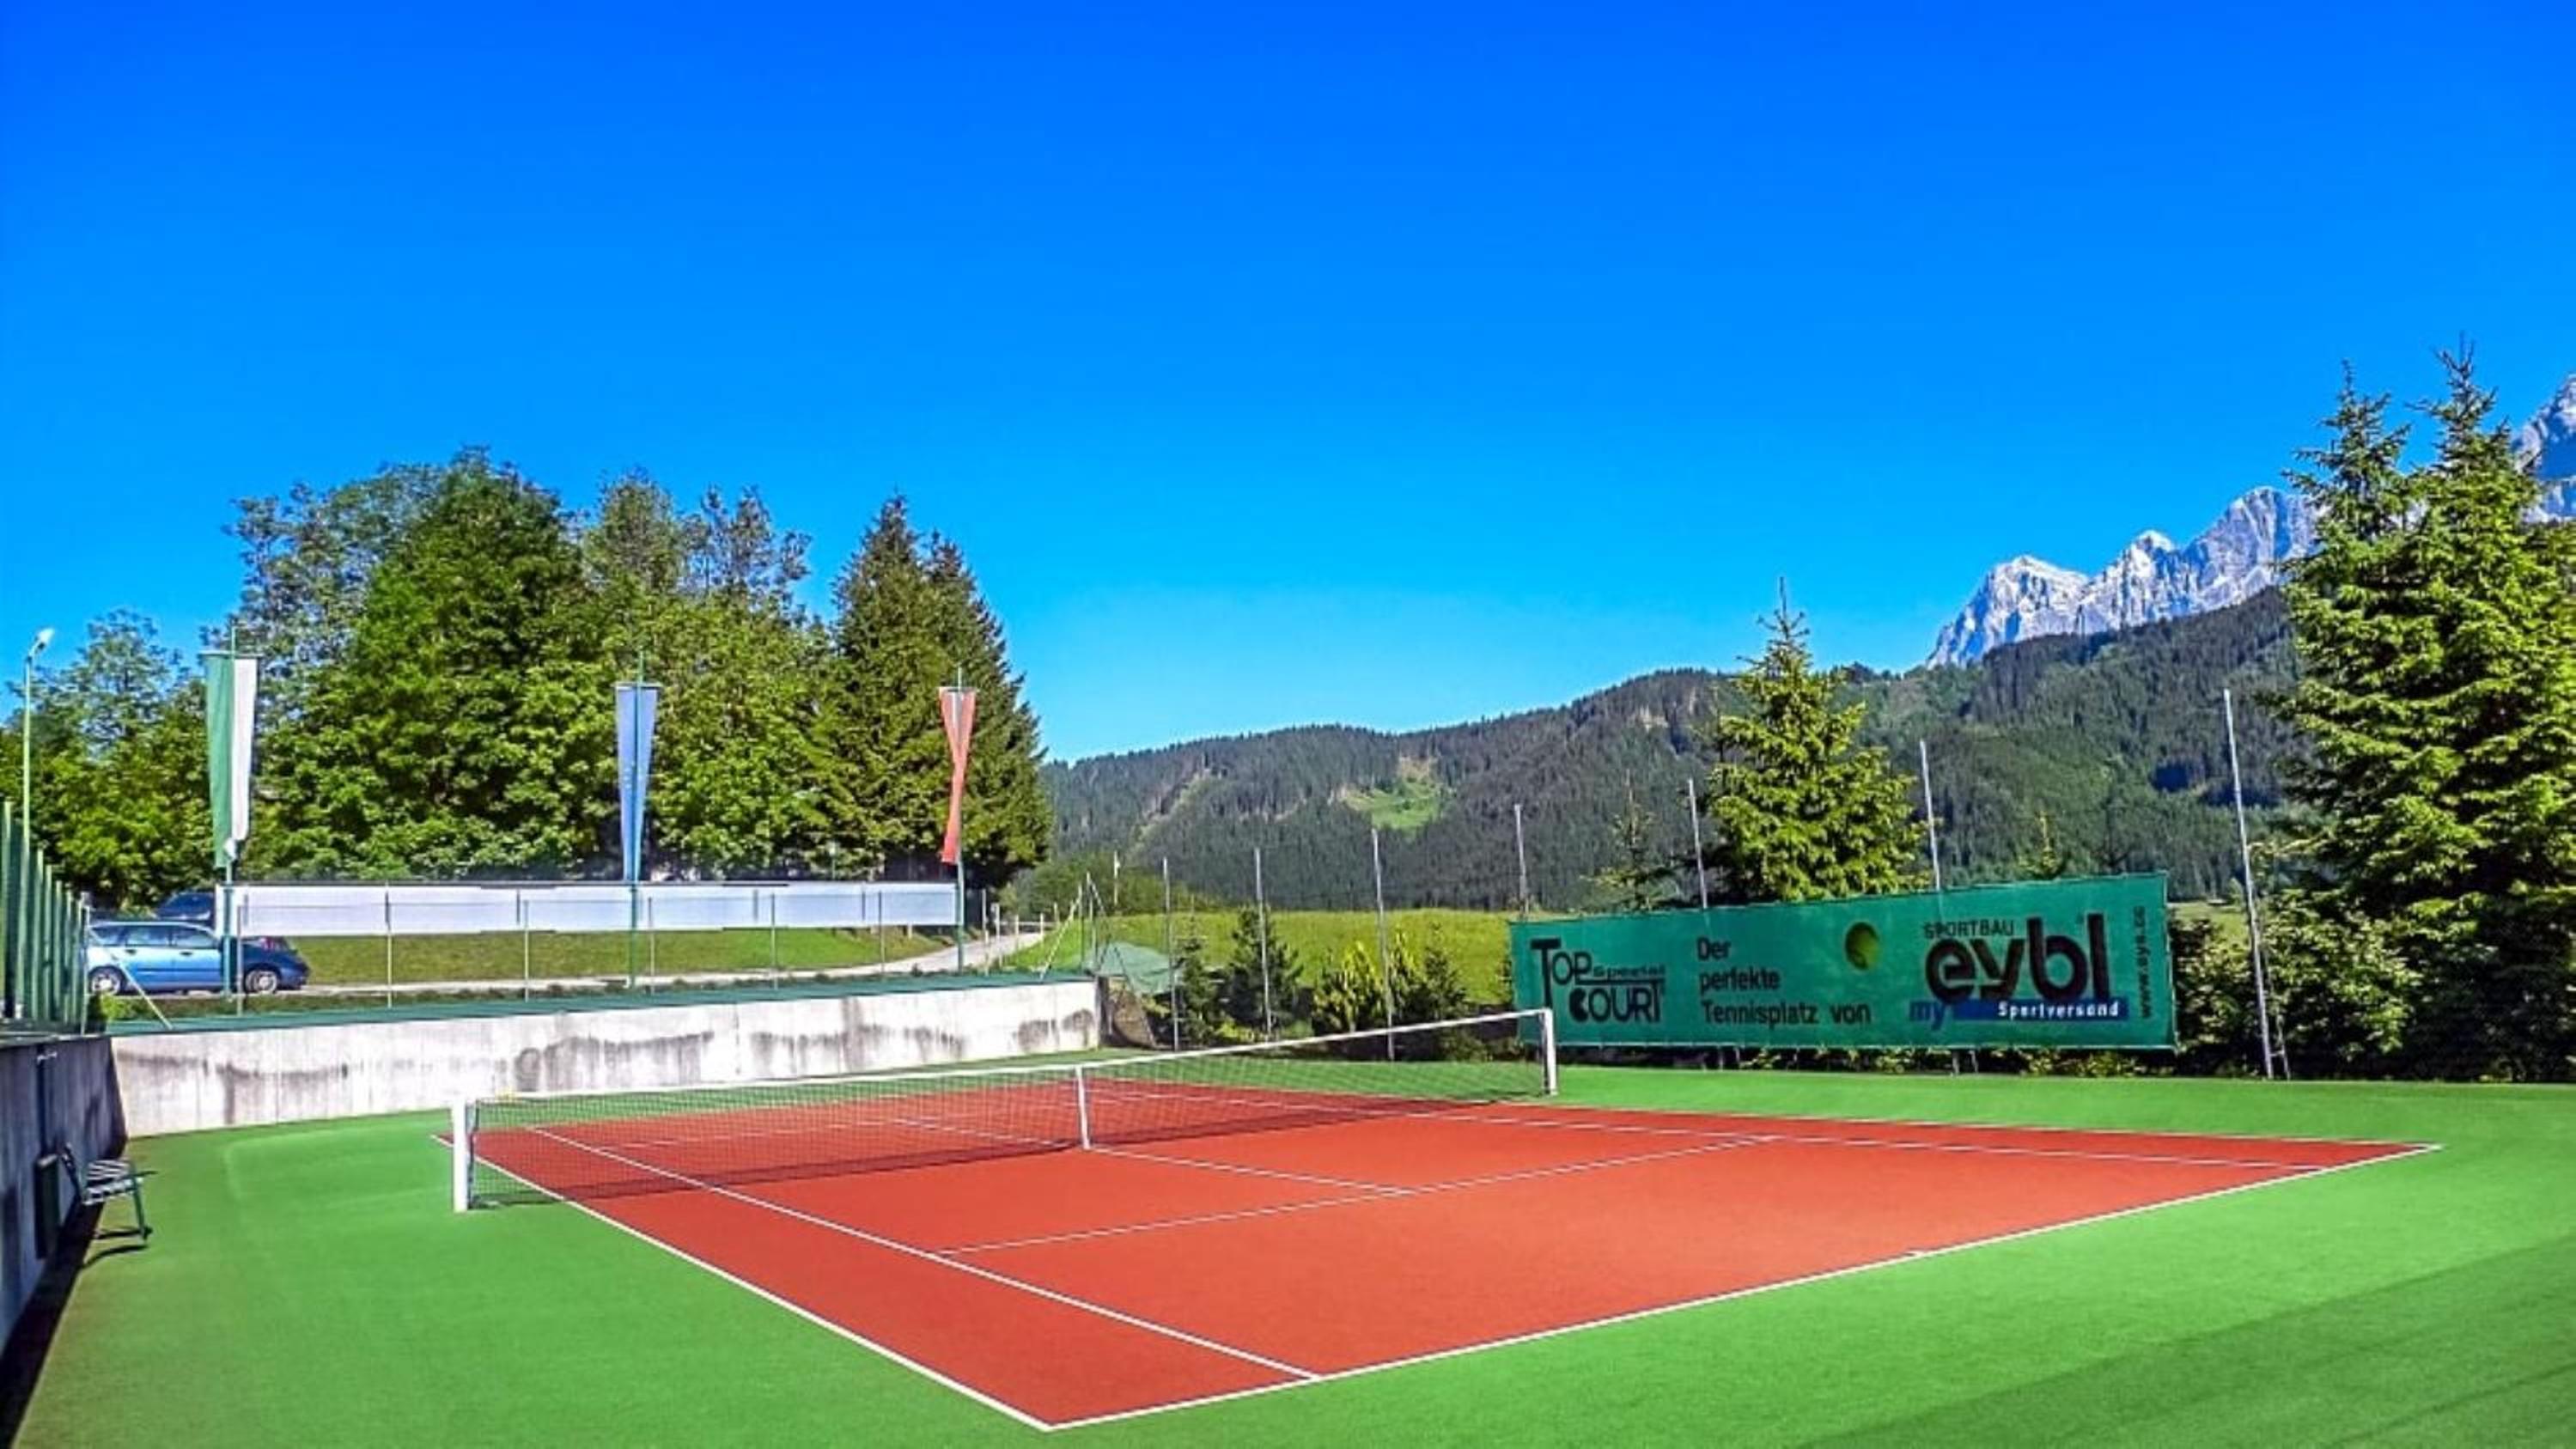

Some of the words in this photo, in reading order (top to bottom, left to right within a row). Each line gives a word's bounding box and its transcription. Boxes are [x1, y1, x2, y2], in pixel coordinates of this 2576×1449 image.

[1924, 920, 2013, 937] SPORTBAU
[1698, 937, 1731, 960] Der
[1925, 913, 2110, 1004] eybl
[1701, 967, 1781, 995] perfekte
[1568, 979, 1665, 1022] COURT
[1702, 1000, 1819, 1029] Tennisplatz
[1830, 1002, 1871, 1023] von
[1998, 1001, 2119, 1020] Sportversand
